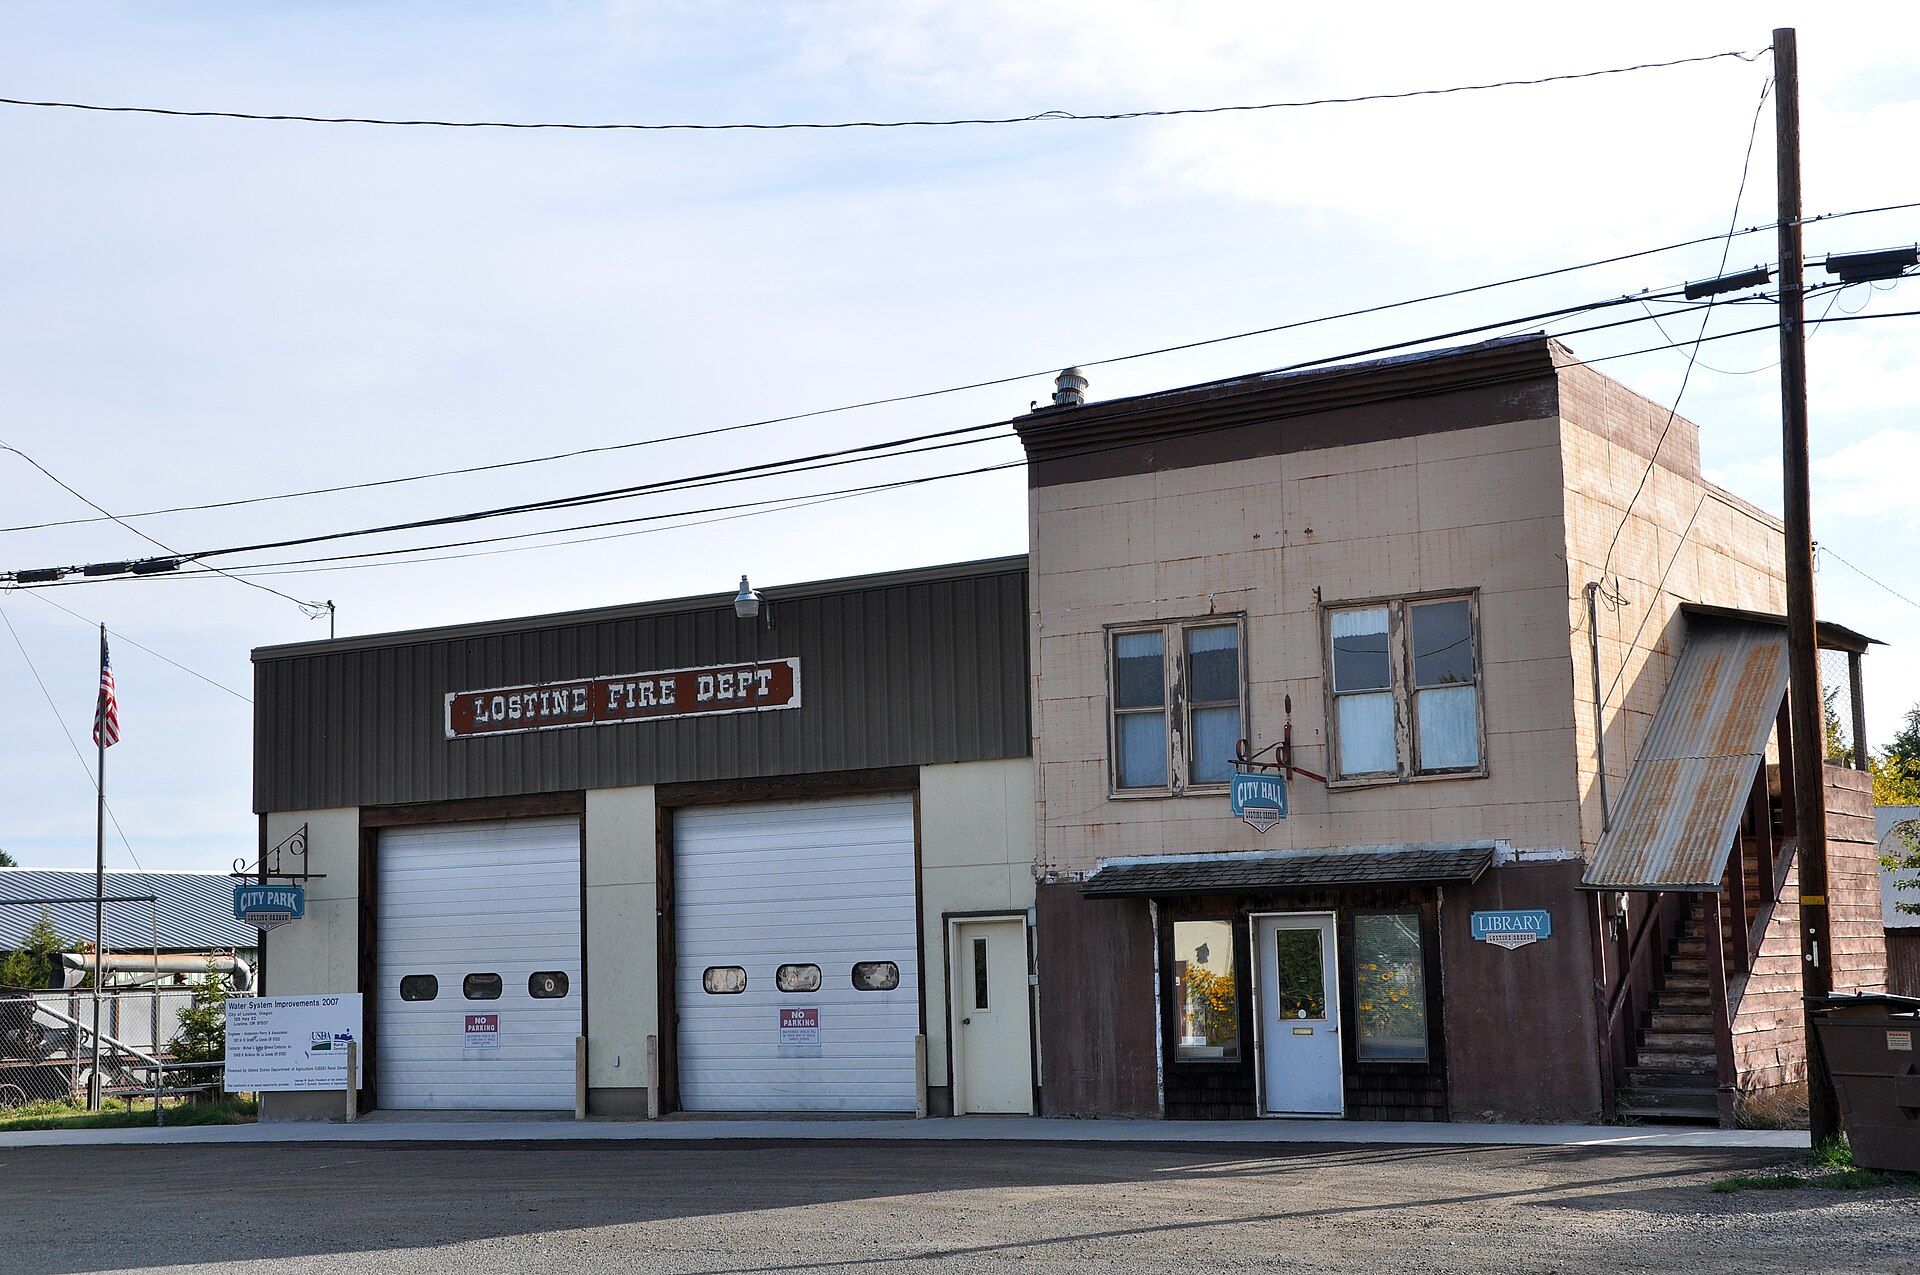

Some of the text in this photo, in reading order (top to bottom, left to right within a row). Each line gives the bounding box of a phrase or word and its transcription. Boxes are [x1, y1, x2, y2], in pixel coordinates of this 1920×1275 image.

[473, 668, 772, 724] LOSTINE FIRE DEPT
[1237, 781, 1283, 810] CITY HALL
[240, 891, 298, 913] CITY PARK
[1478, 915, 1543, 931] LIBRARY
[228, 998, 339, 1010] Water System Improvements 2007
[790, 1011, 805, 1019] NO
[474, 1017, 487, 1025] NO
[783, 1019, 815, 1027] PARKING
[467, 1024, 495, 1032] PARKING
[311, 1031, 332, 1041] USDA
